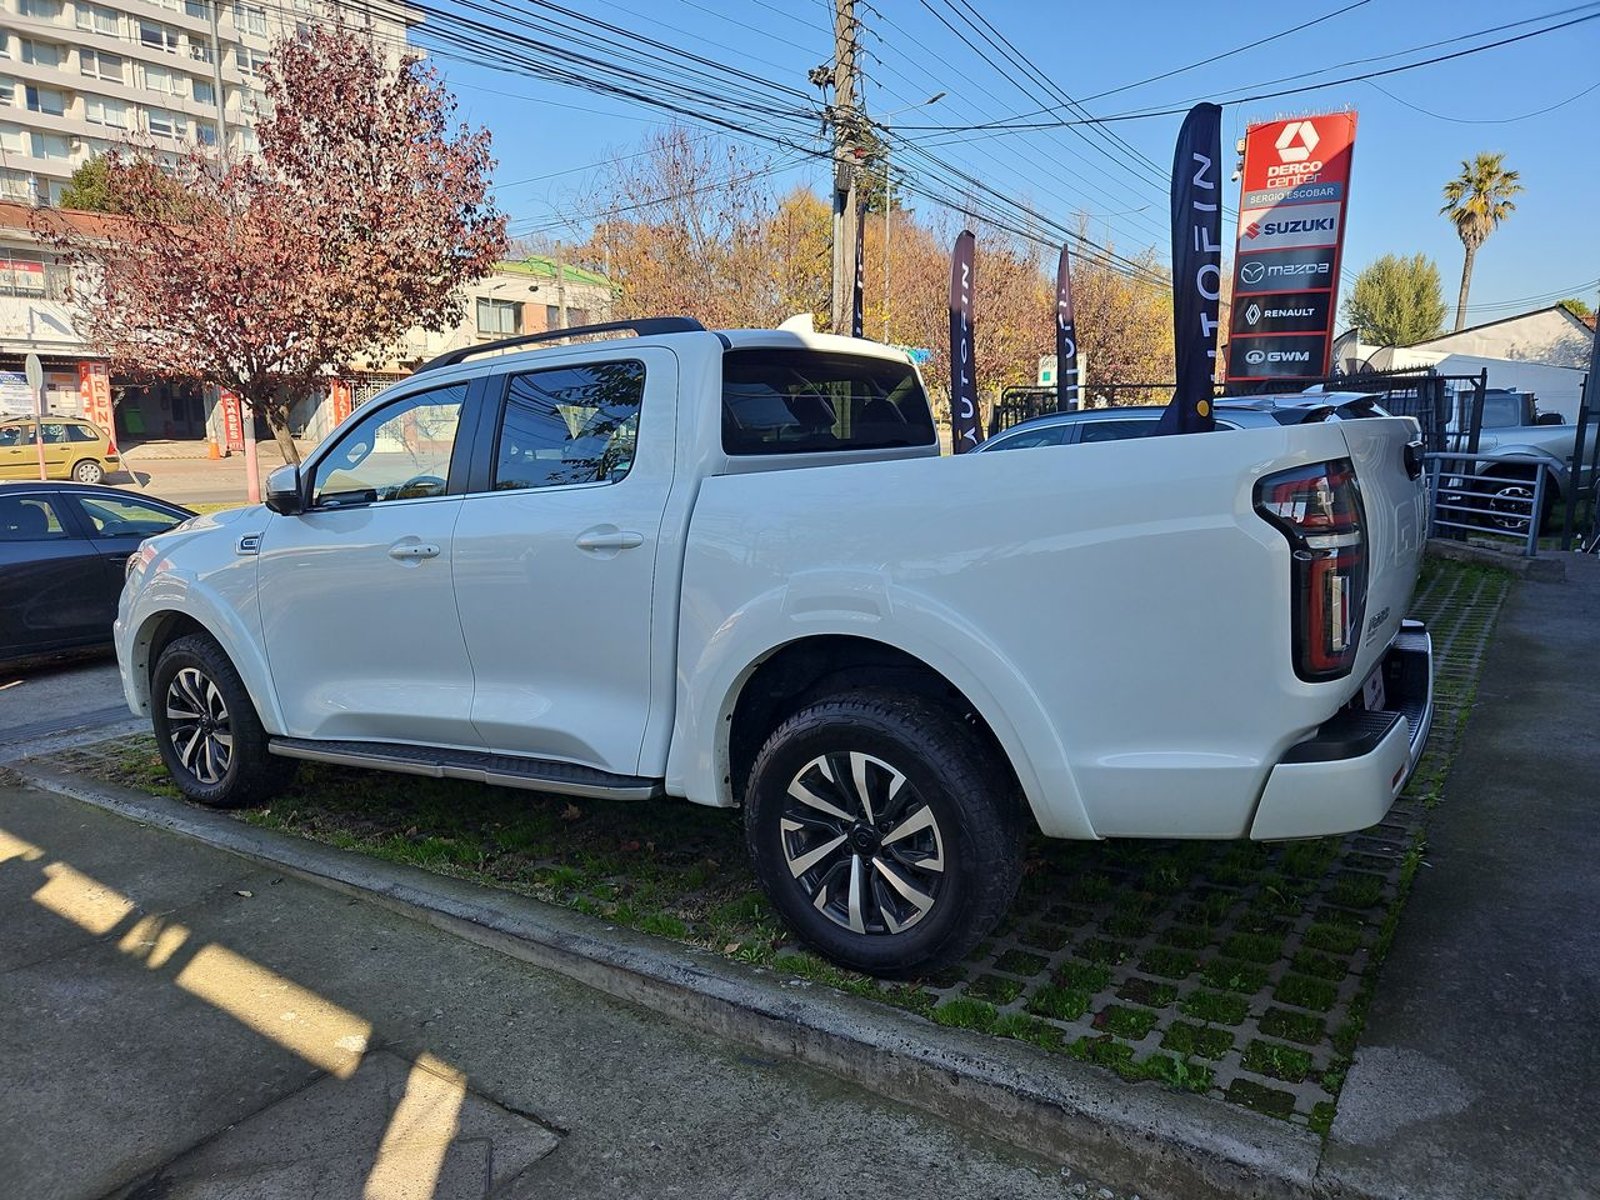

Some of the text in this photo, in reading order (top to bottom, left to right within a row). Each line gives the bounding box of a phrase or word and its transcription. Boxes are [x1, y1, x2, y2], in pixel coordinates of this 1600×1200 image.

[1268, 161, 1323, 177] DERCO
[1267, 173, 1321, 188] center
[1250, 187, 1335, 204] SERGIO ESCOBAR
[1264, 218, 1335, 236] SUZUKI
[1268, 263, 1330, 276] mazda
[1264, 308, 1316, 318] RENAULT
[1267, 351, 1310, 362] GWM
